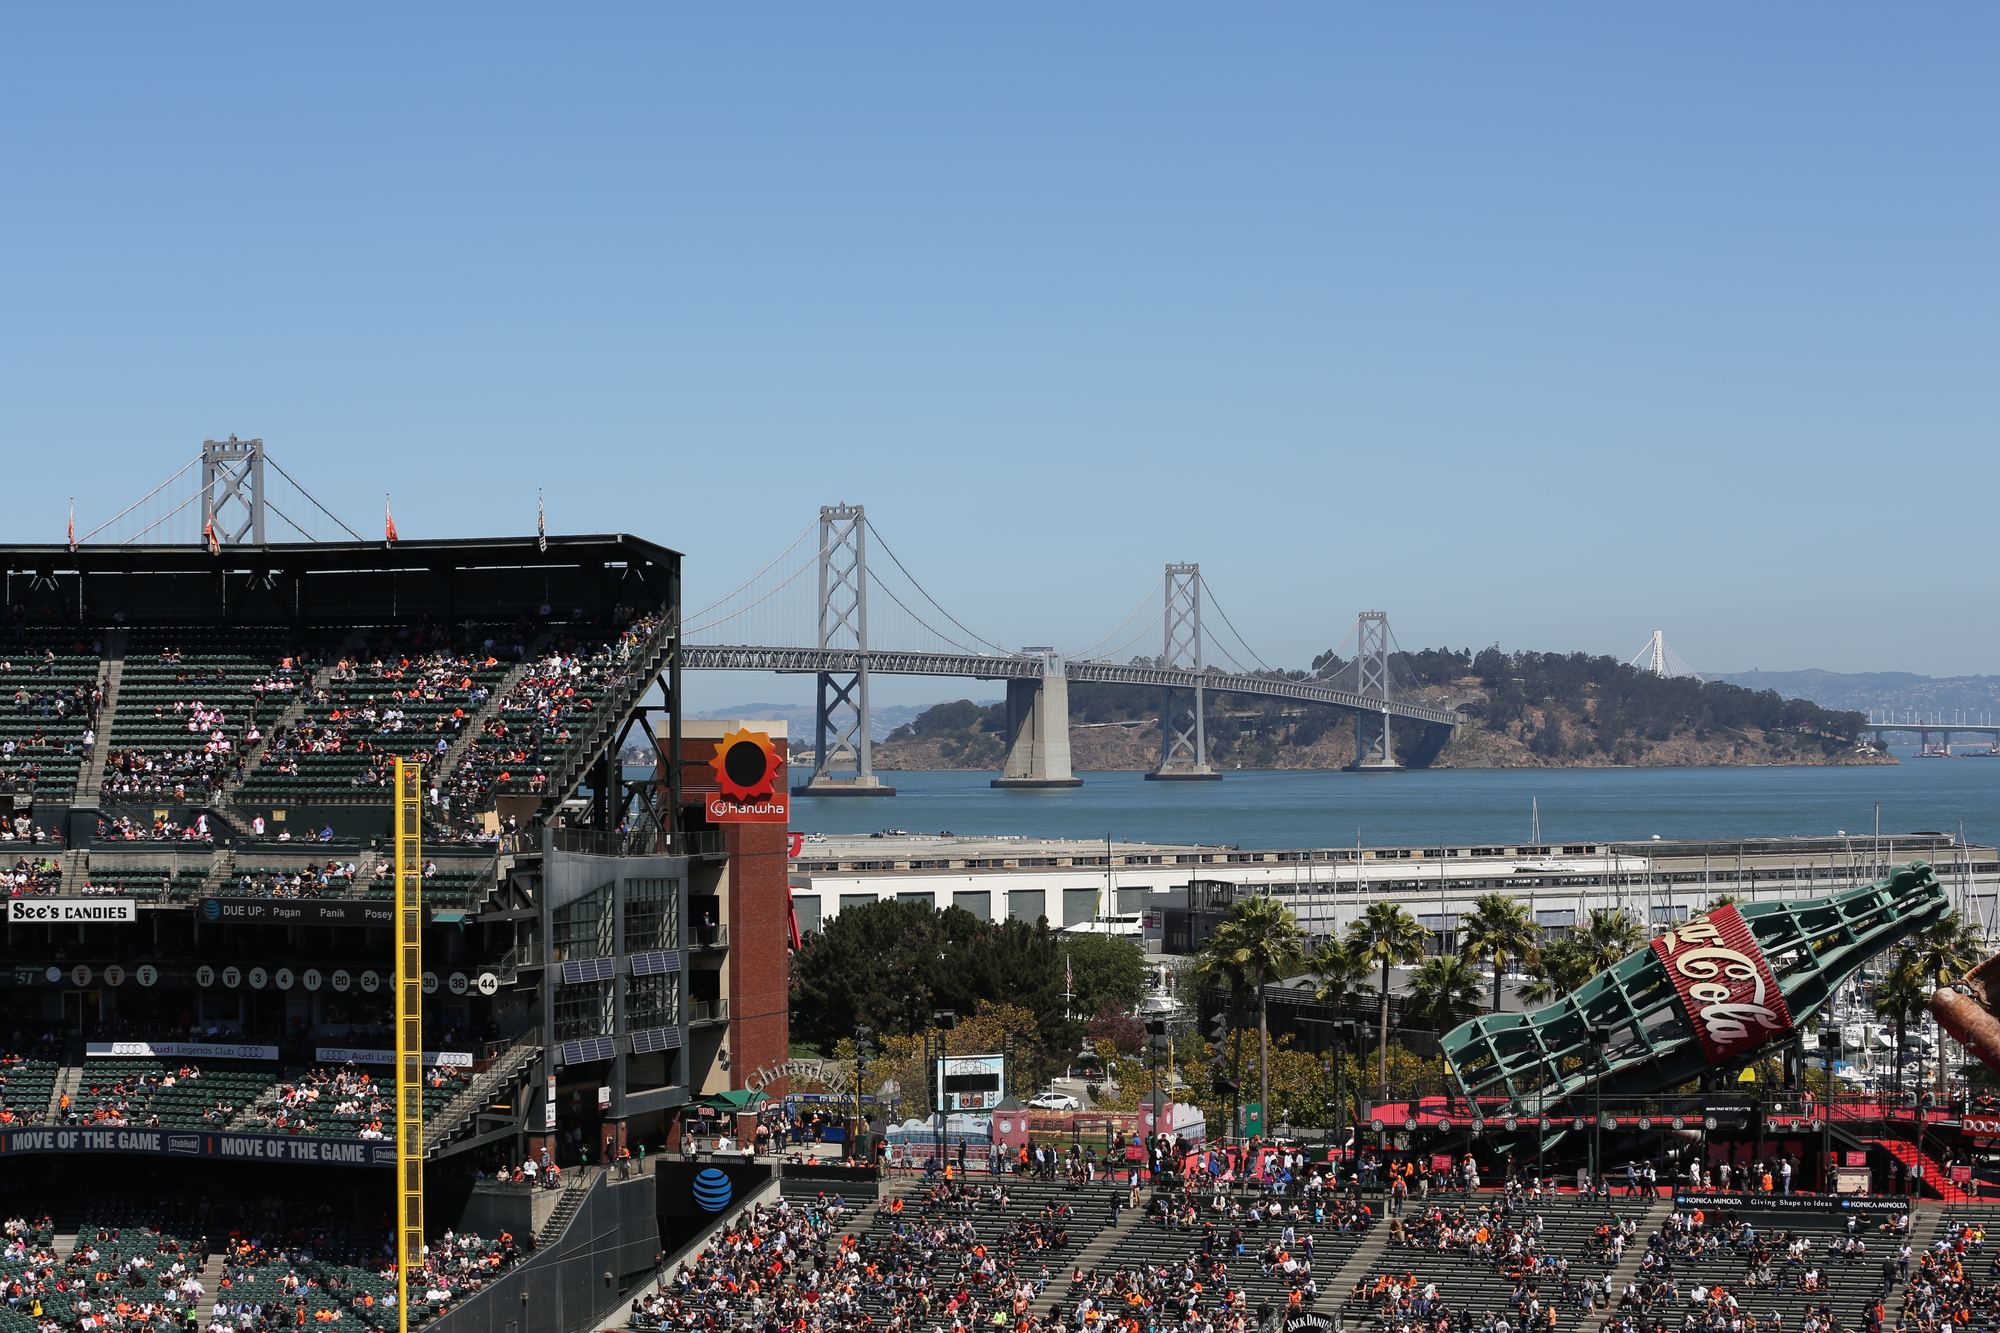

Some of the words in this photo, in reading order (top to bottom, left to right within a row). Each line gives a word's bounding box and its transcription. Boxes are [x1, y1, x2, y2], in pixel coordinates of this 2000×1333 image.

[13, 902, 59, 919] See's
[65, 907, 127, 919] CANDIES
[223, 905, 245, 916] DUE
[248, 906, 266, 917] UP:
[273, 907, 300, 919] Pagan
[320, 908, 345, 918] Panik
[365, 909, 393, 921] Posey
[255, 974, 262, 983] 3
[281, 974, 288, 984] 4
[308, 975, 316, 985] 11
[335, 976, 347, 986] 20
[364, 976, 377, 986] 24
[423, 977, 434, 987] 30
[452, 978, 465, 988] 36
[481, 979, 495, 988] 44
[149, 1045, 174, 1053] Audi
[177, 1045, 212, 1056] Legends
[215, 1046, 234, 1055] Club
[351, 1051, 374, 1061] Audi
[422, 1055, 437, 1063] lub
[12, 1132, 54, 1150] MOVE
[57, 1132, 81, 1149] OF
[82, 1131, 115, 1149] THE
[118, 1132, 161, 1151] GAME
[221, 1137, 263, 1156] MOVE
[266, 1139, 286, 1158] OF
[288, 1141, 318, 1160] THE
[321, 1143, 365, 1162] GAME
[375, 1149, 398, 1160] StubHu
[1686, 1196, 1712, 1204] KONICA
[1713, 1197, 1742, 1205] MINOLTA
[1750, 1198, 1776, 1207] Giving
[1779, 1199, 1801, 1207] Shape
[1850, 1200, 1877, 1208] KONICA
[1878, 1201, 1908, 1209] MINOLTA
[1287, 1316, 1307, 1332] JACK
